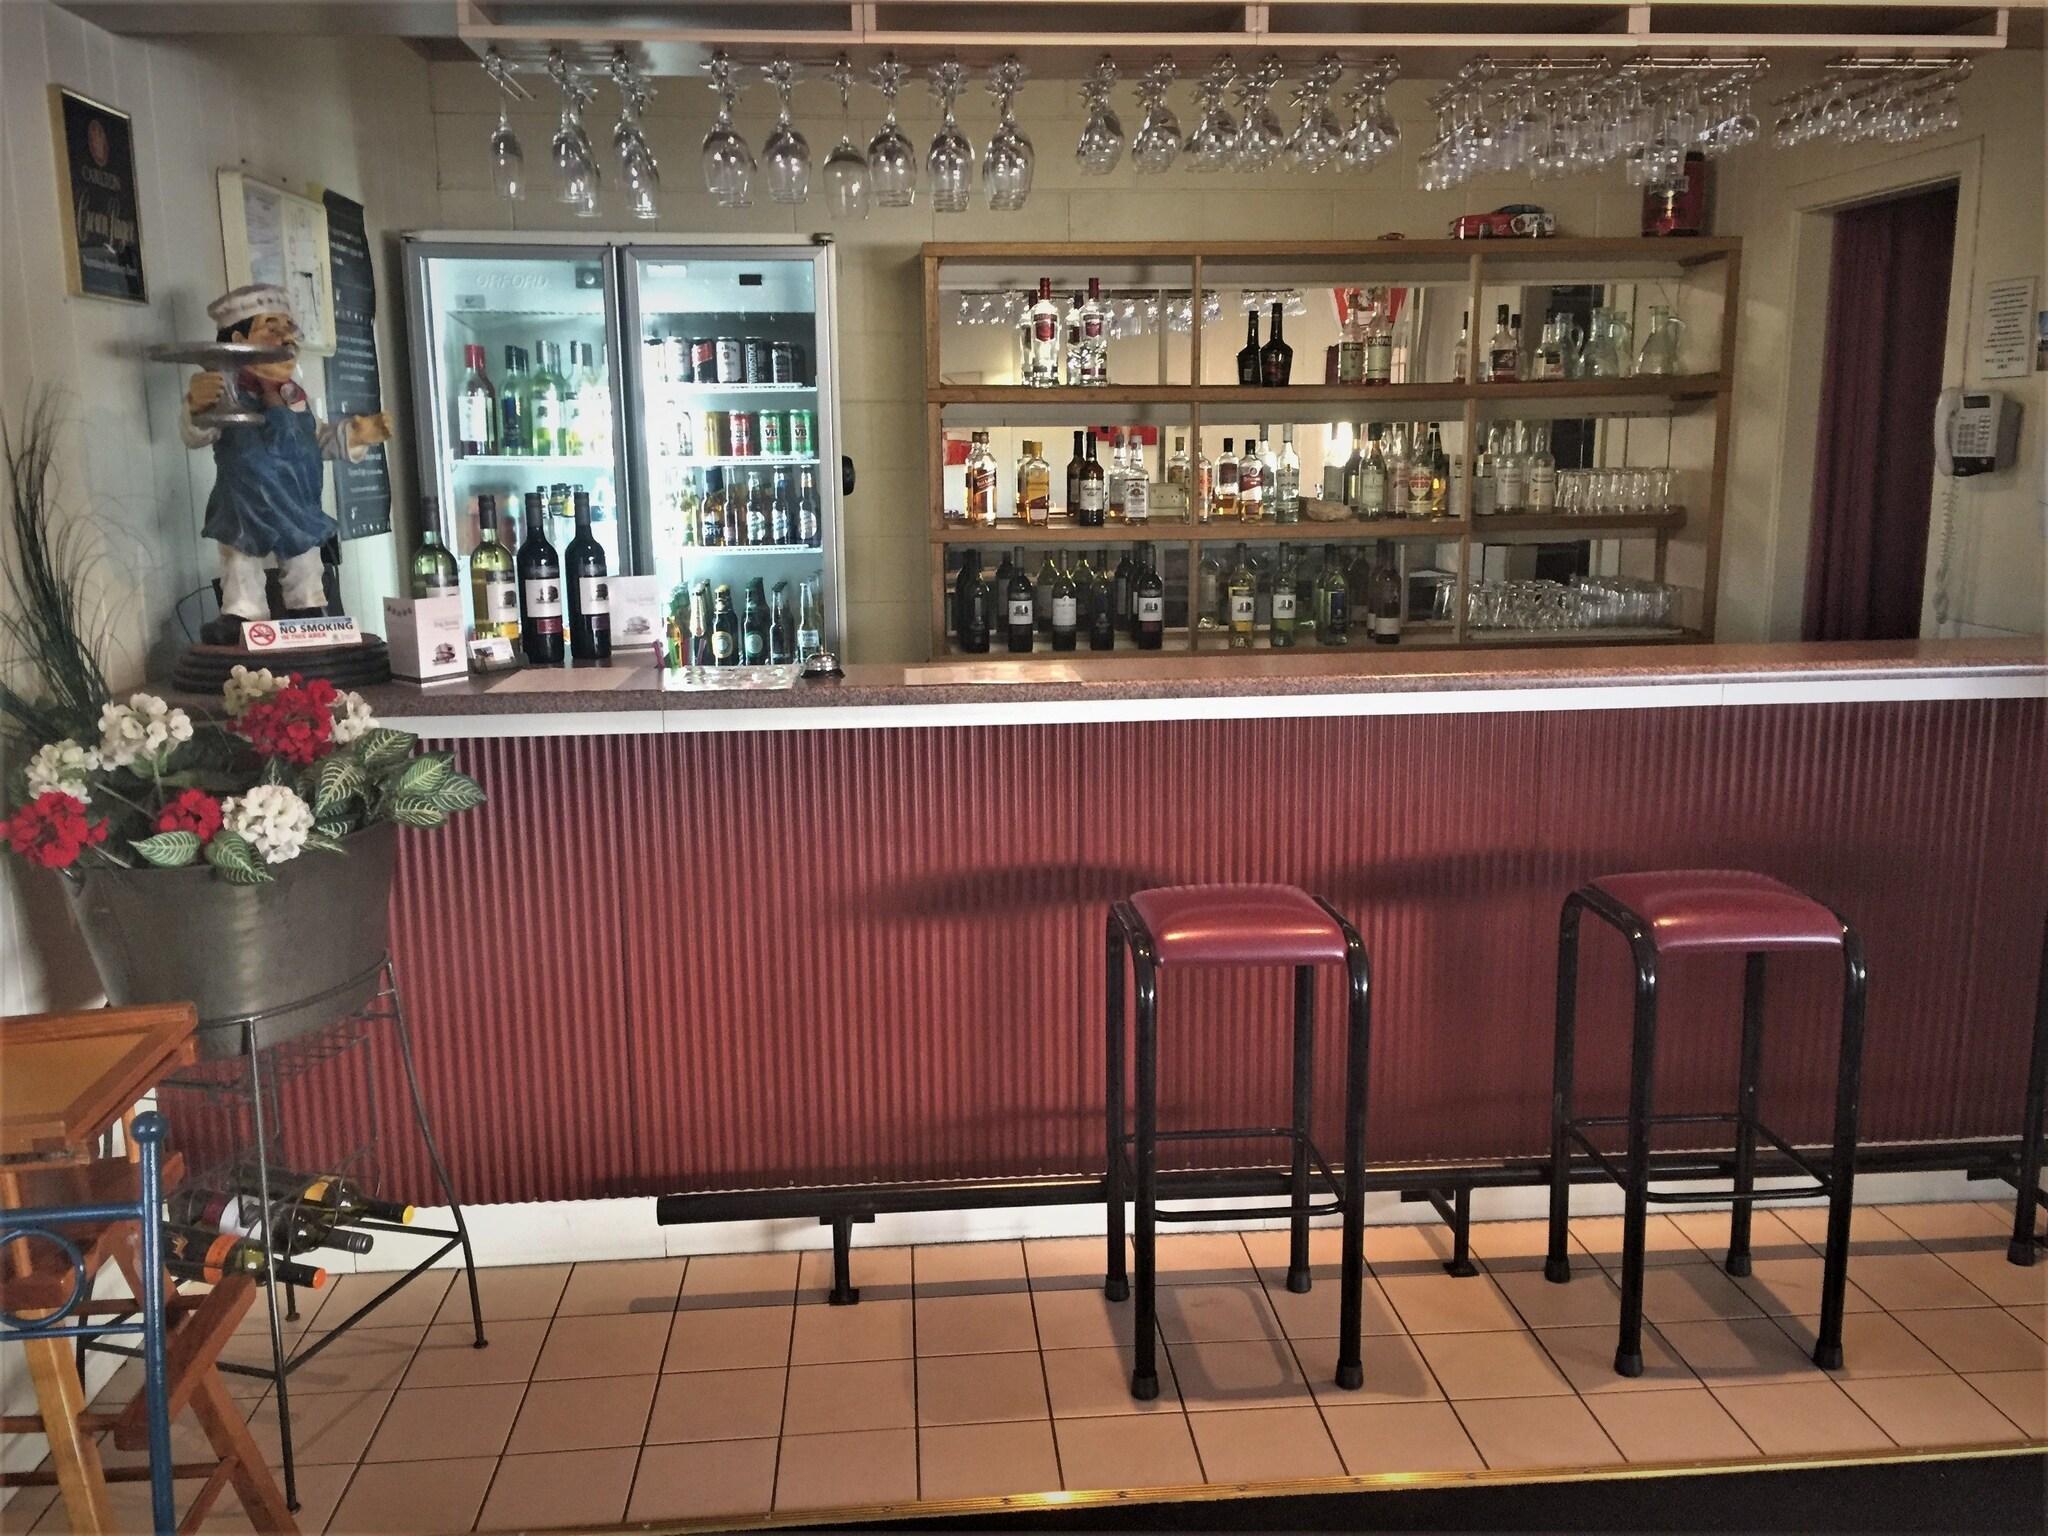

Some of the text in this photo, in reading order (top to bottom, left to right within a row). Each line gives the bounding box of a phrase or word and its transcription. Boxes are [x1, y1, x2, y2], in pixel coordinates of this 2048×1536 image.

[475, 272, 549, 289] ORFORD
[765, 429, 778, 437] VB
[795, 429, 807, 437] VB
[703, 527, 721, 536] DRY
[280, 621, 354, 634] NO SMOKING
